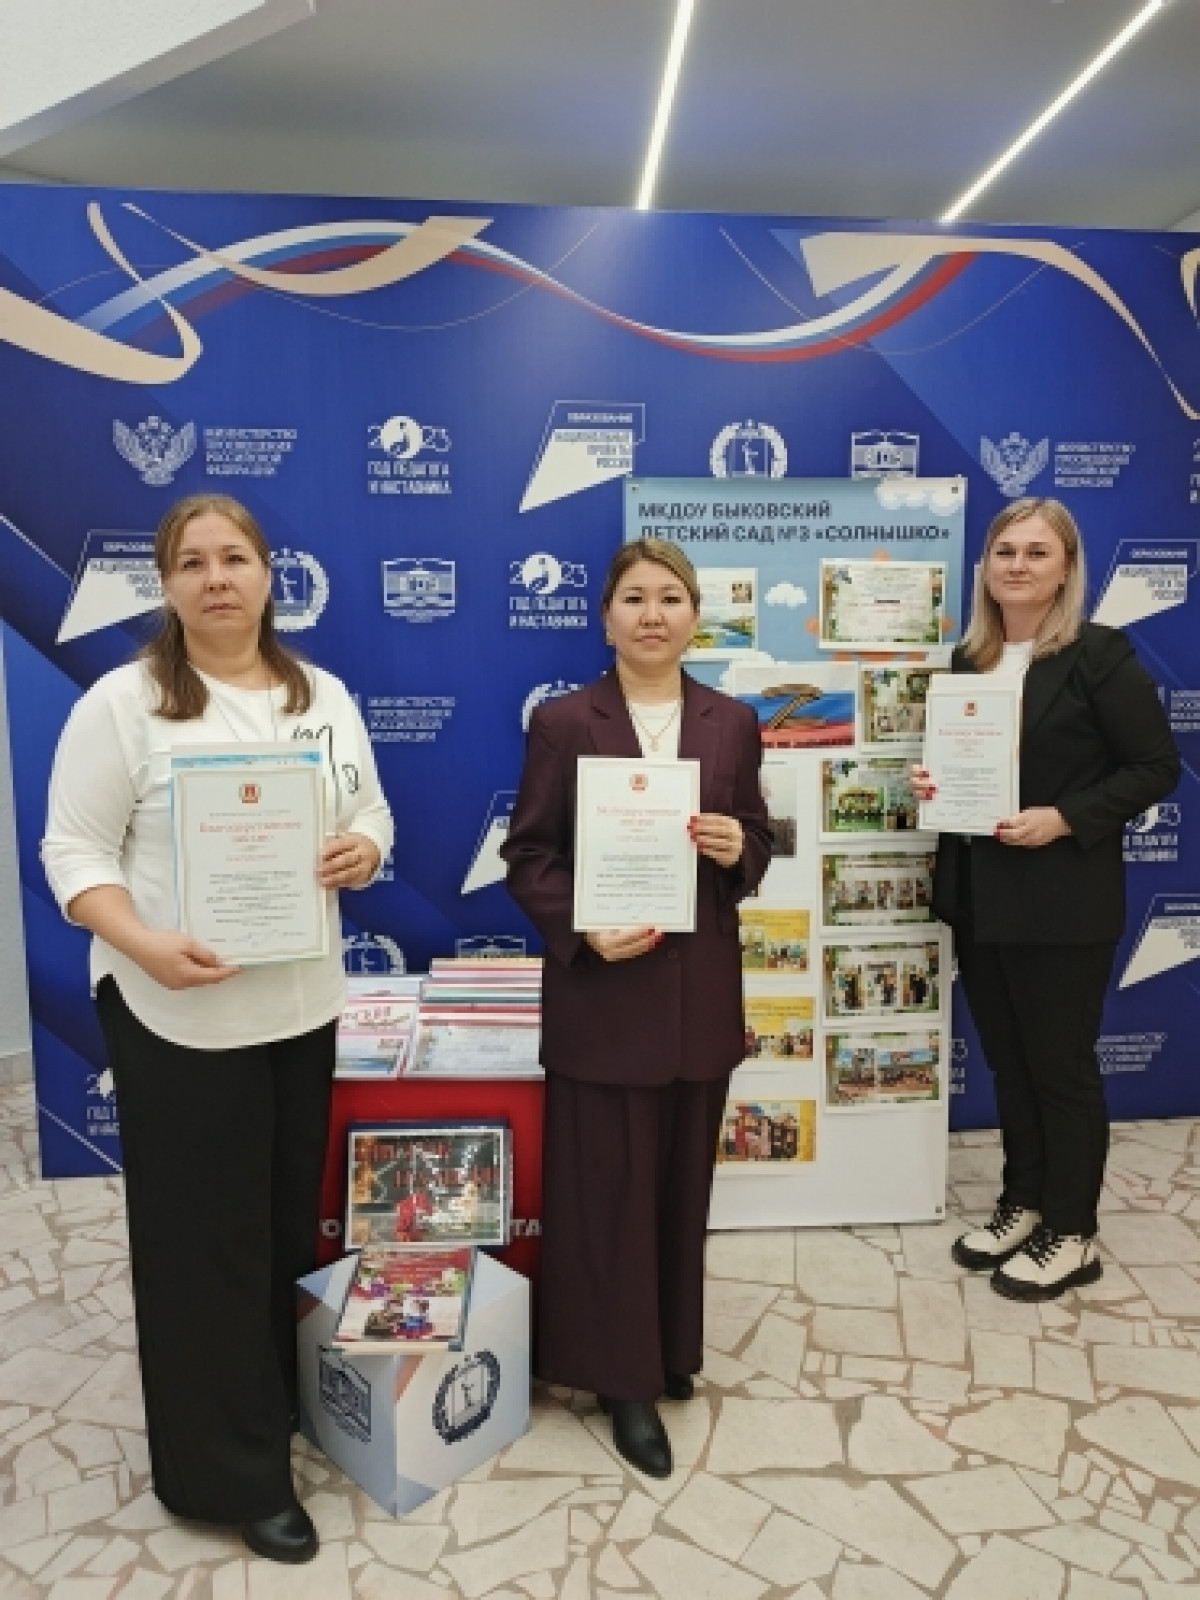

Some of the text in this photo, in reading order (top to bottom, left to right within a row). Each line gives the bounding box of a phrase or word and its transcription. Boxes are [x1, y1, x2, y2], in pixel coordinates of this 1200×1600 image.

[638, 500, 831, 520] МКДОУ БЫКОВСКИЙ
[641, 523, 729, 541] ДЕТСКИЙ
[732, 525, 775, 544] САД
[815, 525, 950, 542] «СОЛНЫШКО»
